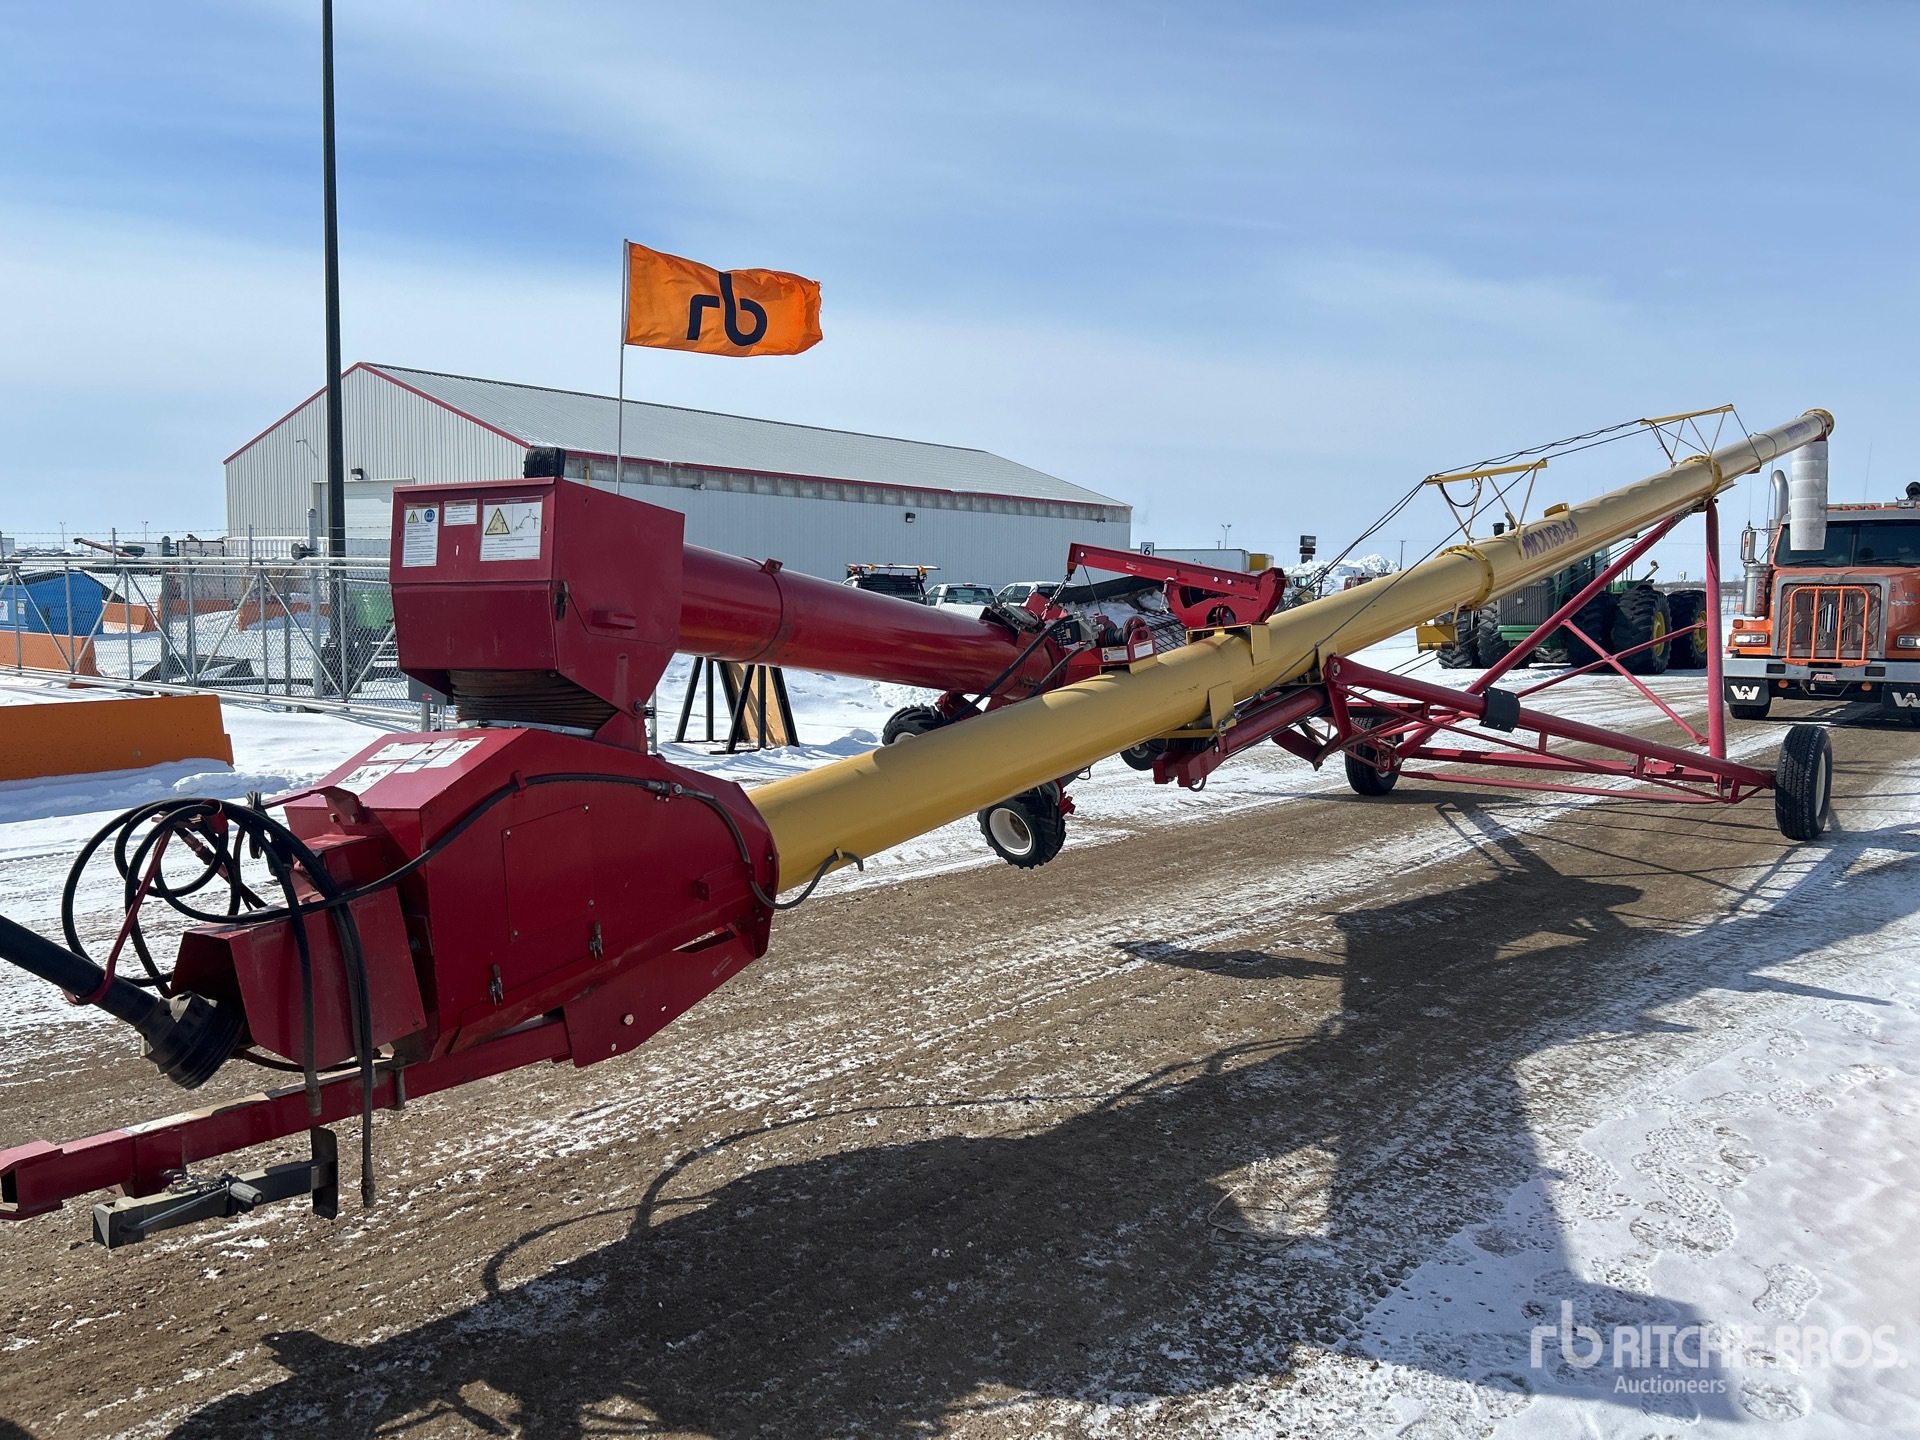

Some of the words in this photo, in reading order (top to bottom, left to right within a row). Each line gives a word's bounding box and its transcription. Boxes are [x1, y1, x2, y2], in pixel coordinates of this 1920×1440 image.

[686, 271, 768, 346] rb
[1143, 546, 1151, 555] 6
[1522, 518, 1579, 560] MKX130-64
